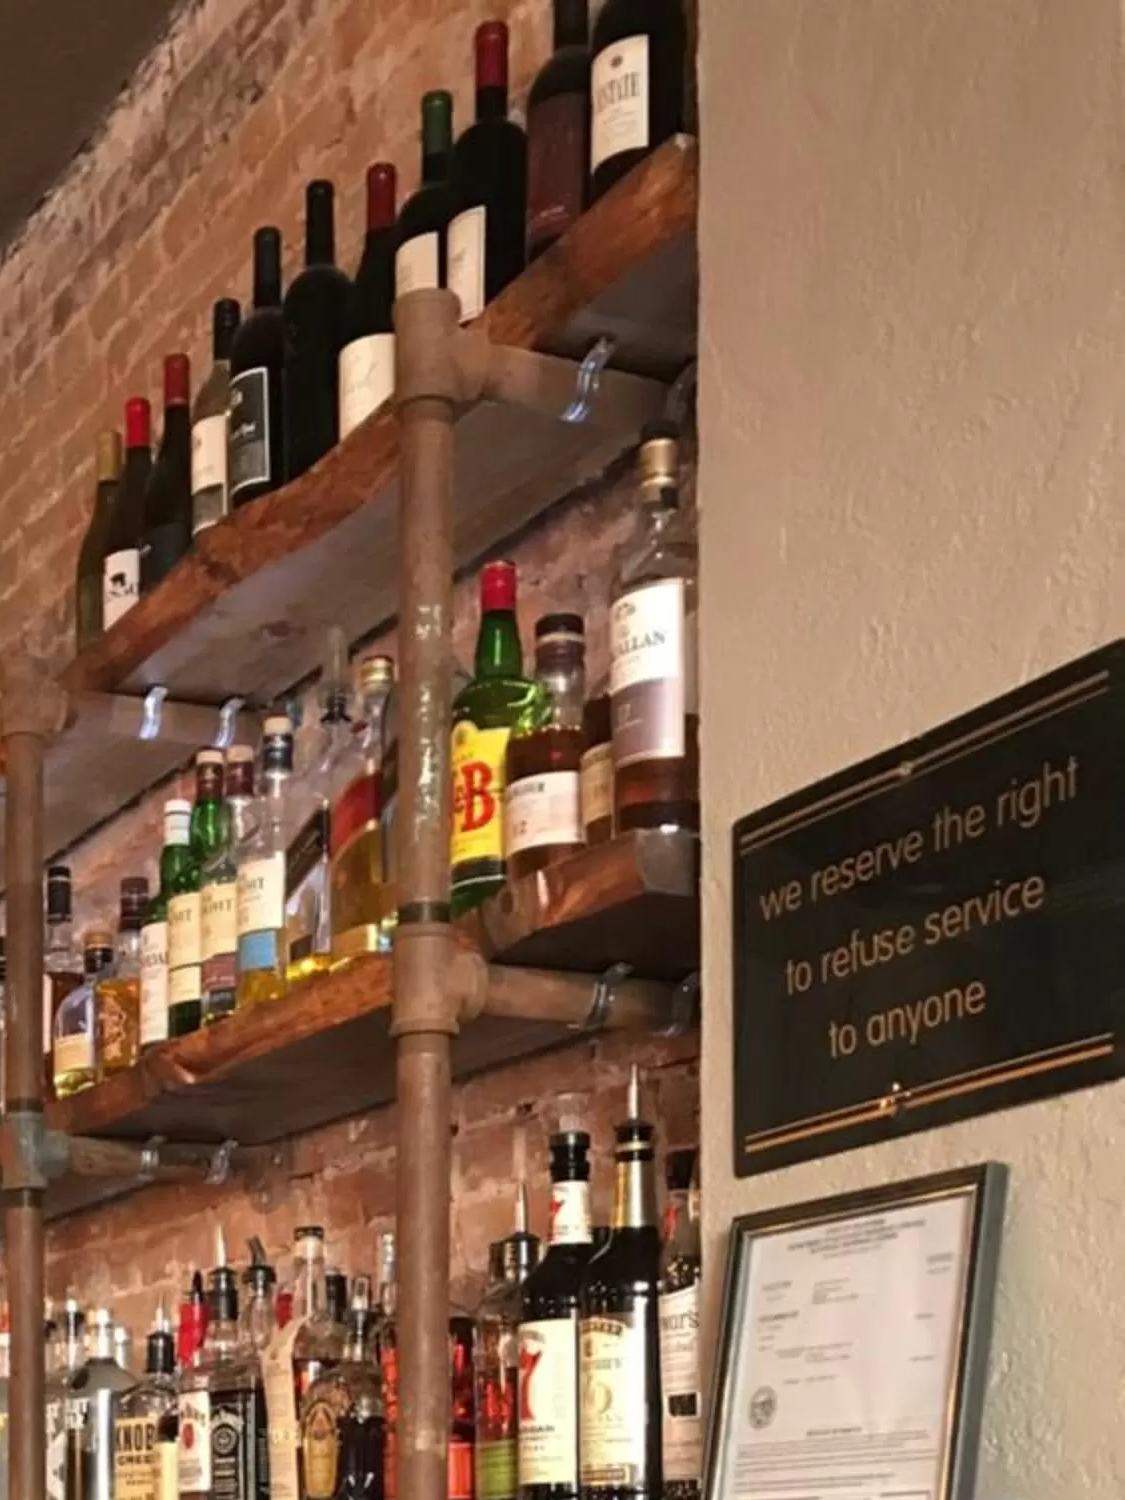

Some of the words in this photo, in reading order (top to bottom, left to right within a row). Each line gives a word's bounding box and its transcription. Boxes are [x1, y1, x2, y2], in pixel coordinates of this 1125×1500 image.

[759, 880, 802, 921] we
[811, 831, 923, 902] reserve
[933, 805, 986, 852] the
[996, 755, 1079, 828] right
[786, 959, 812, 995] to
[821, 928, 916, 984] refuse
[924, 875, 1045, 945] service
[829, 1020, 857, 1059] to
[866, 980, 987, 1045] anyone
